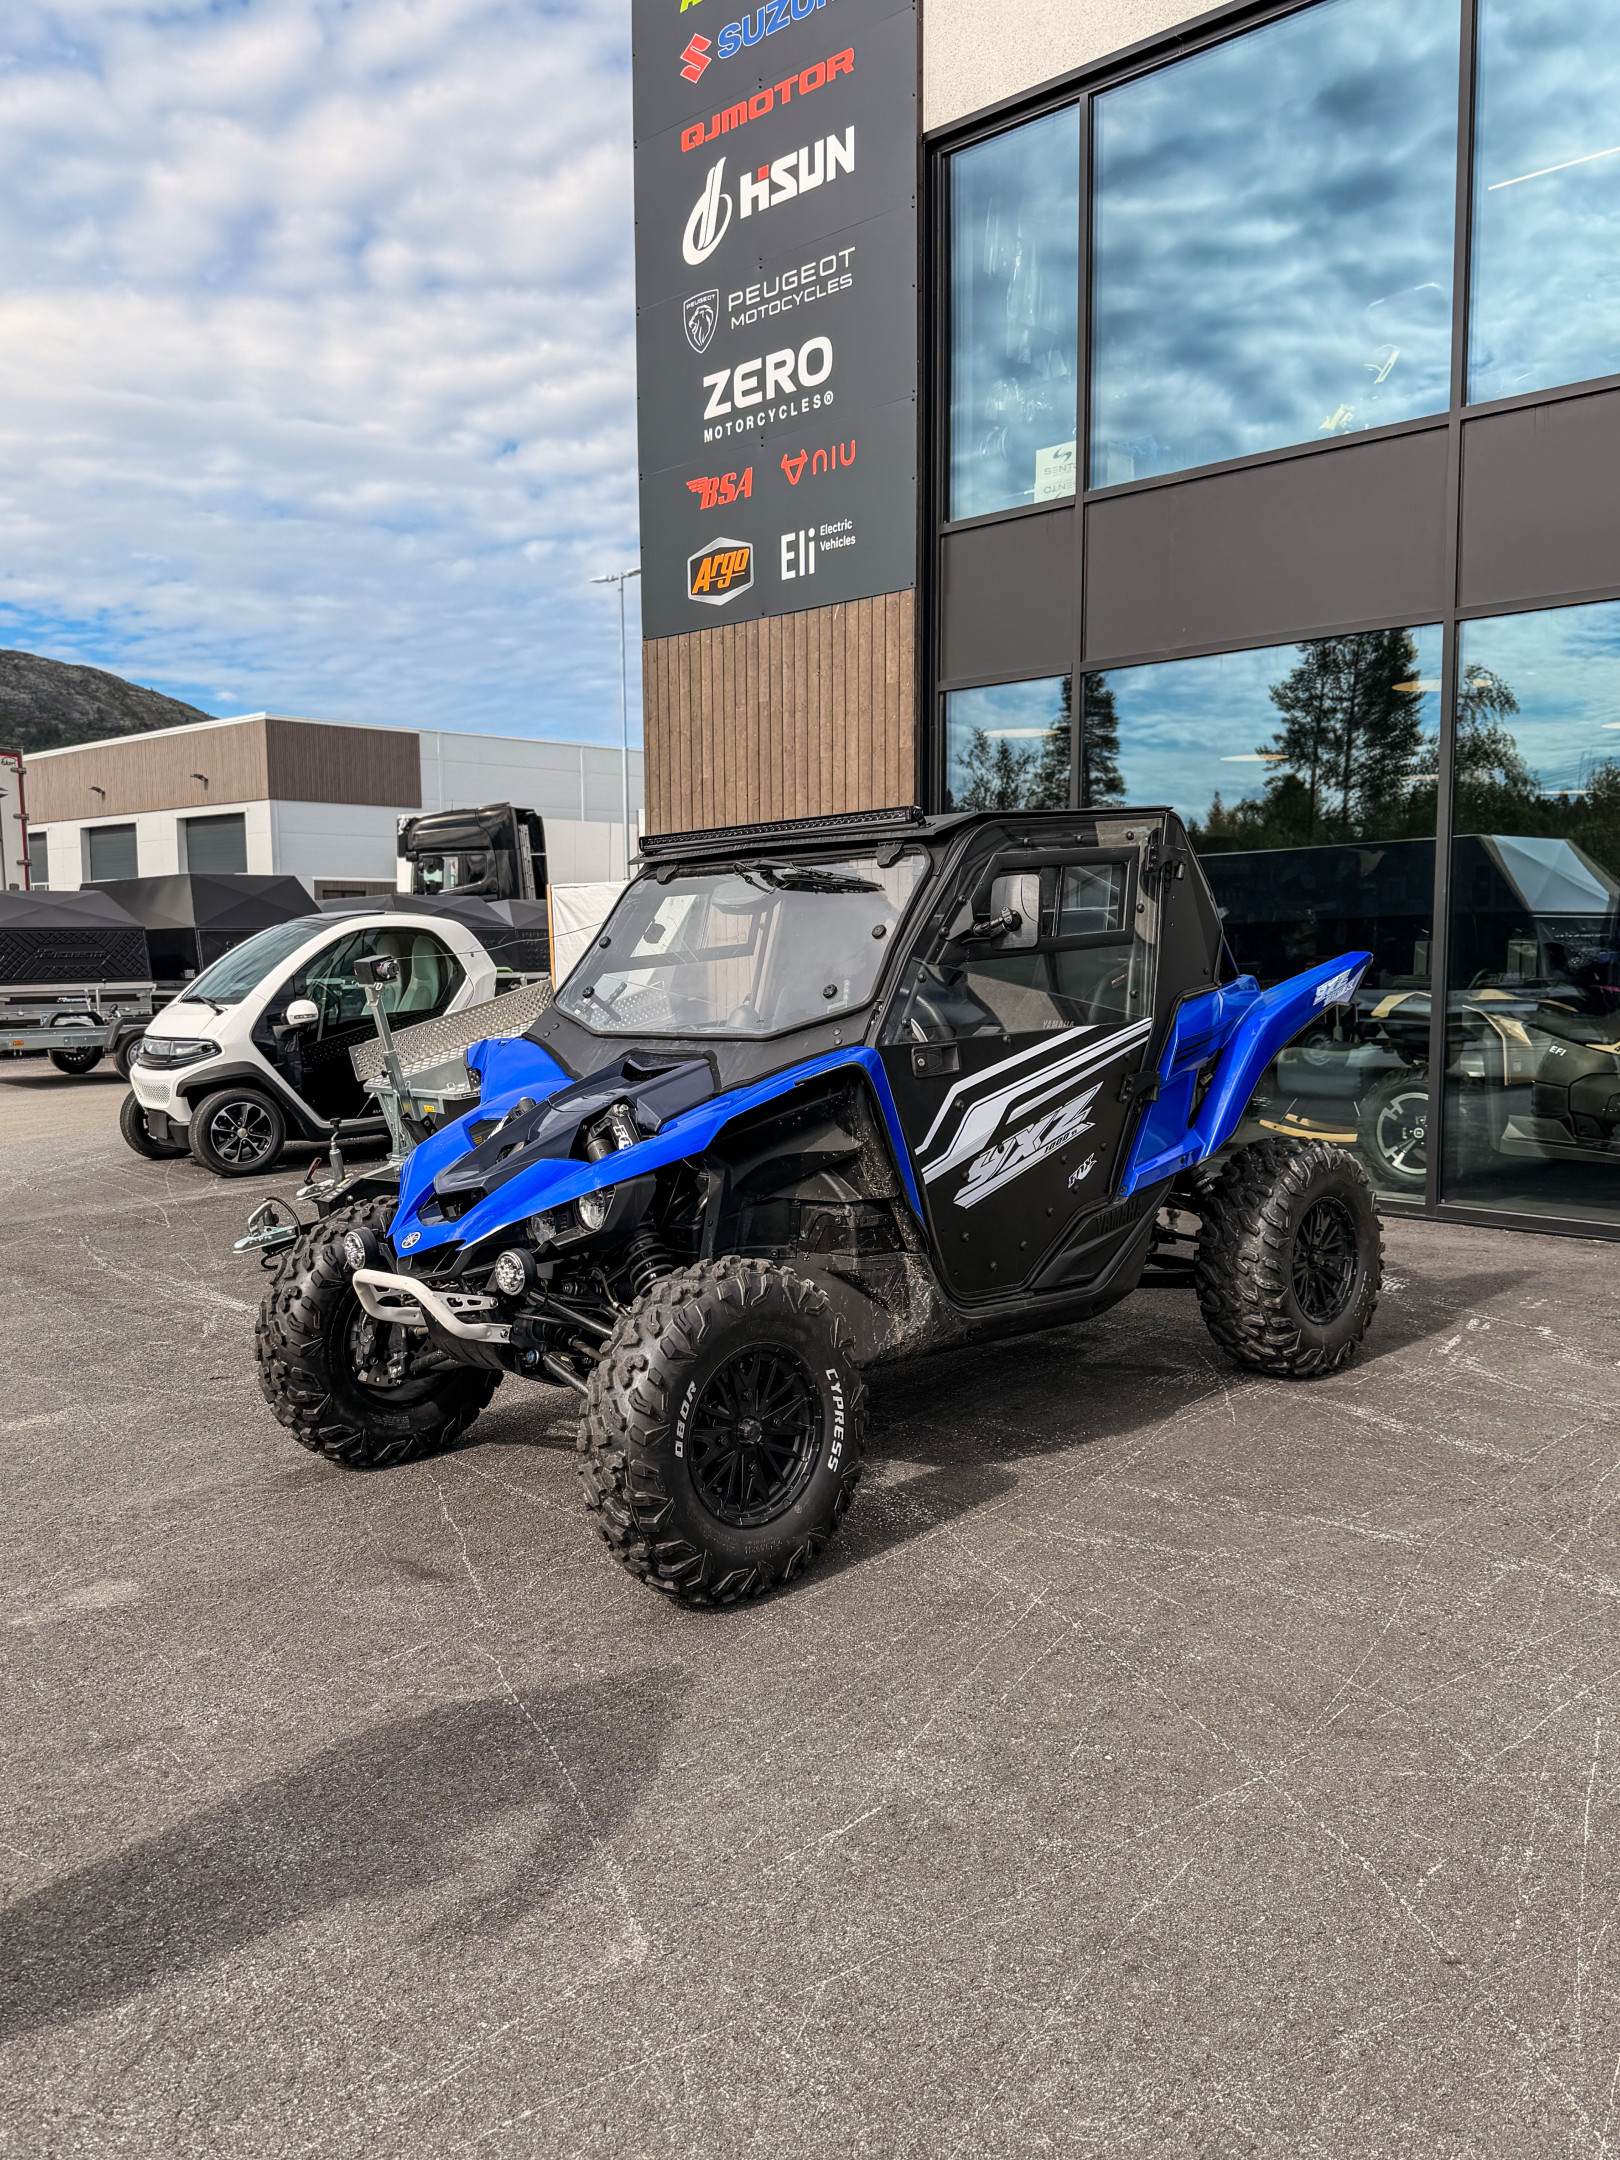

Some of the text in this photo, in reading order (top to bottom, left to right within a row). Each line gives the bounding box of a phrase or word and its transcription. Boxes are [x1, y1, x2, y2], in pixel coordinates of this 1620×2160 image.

[717, 0, 835, 59] SUZU
[681, 47, 855, 153] QJMOTOR
[686, 294, 716, 310] PEUGEOT
[728, 246, 856, 312] PEUGEOT
[731, 273, 853, 330] MOTOCYCLES
[703, 336, 833, 421] ZERO
[700, 466, 753, 510] BSA
[780, 527, 816, 581] Eli
[820, 518, 853, 536] Electric
[820, 535, 856, 552] Vehicles
[692, 548, 750, 594] Argo
[1549, 1045, 1567, 1057] EFI
[953, 1081, 1104, 1201] YXZ
[1067, 1152, 1098, 1189] FOX
[825, 1368, 845, 1473] CYPRESS
